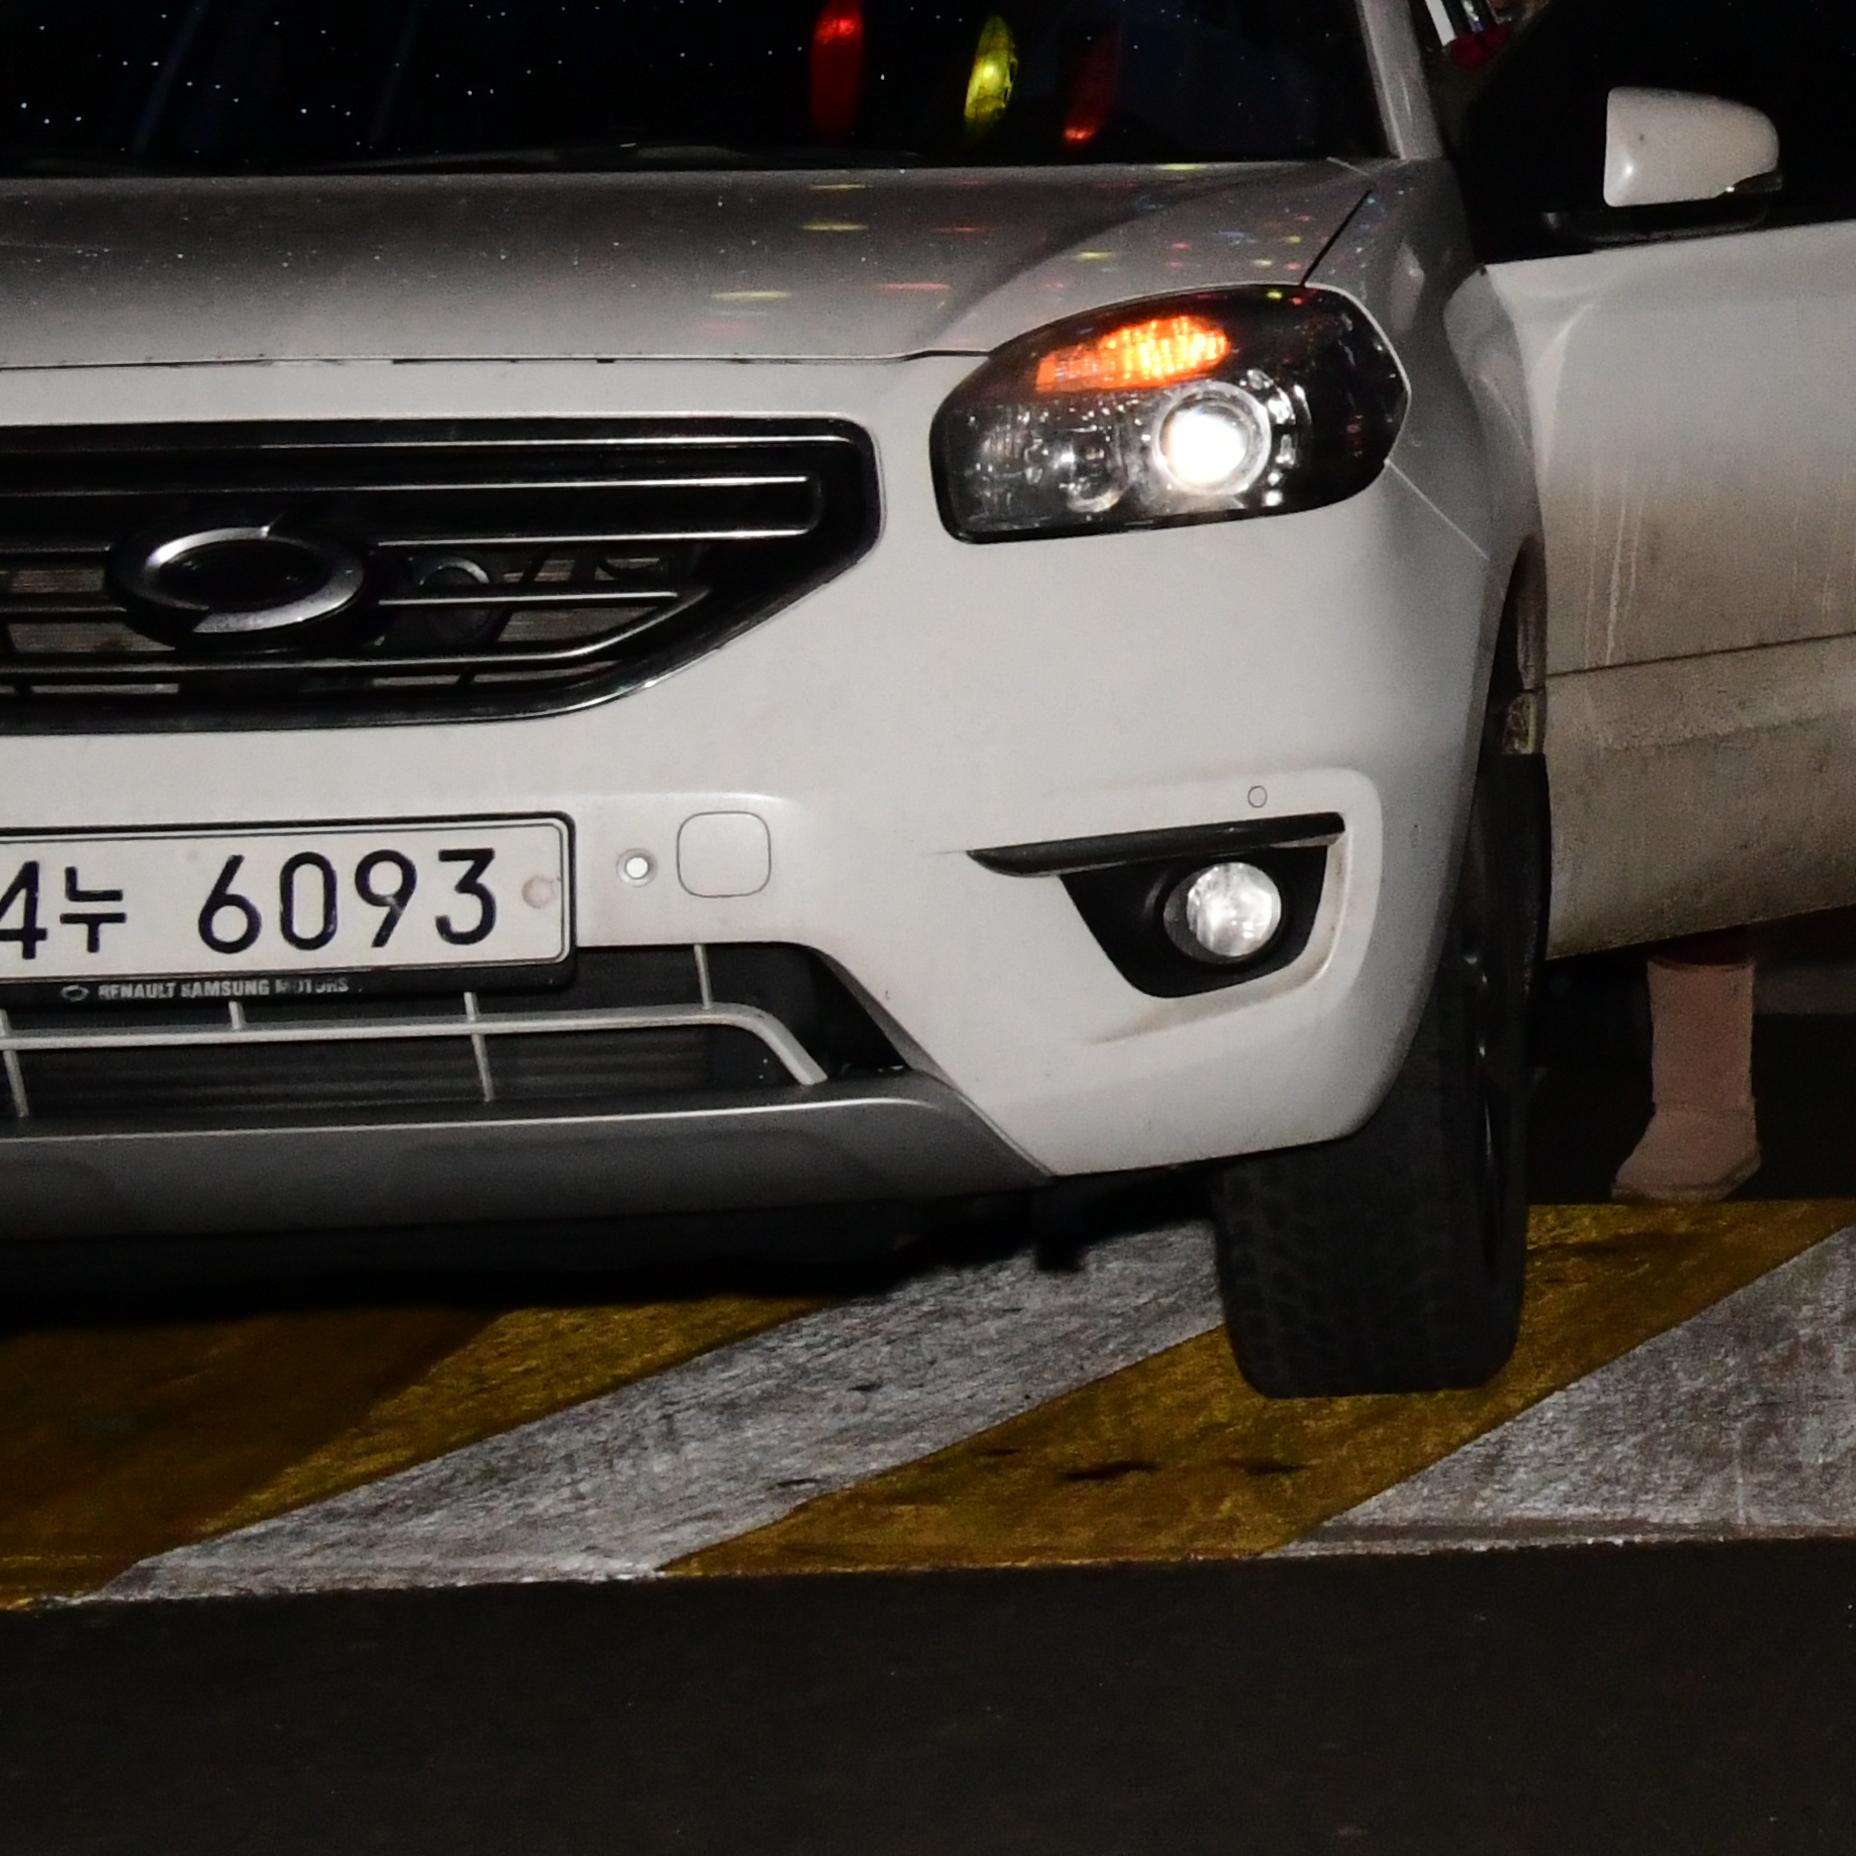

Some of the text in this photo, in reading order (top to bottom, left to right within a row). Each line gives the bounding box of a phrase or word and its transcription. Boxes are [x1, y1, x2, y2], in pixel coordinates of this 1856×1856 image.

[199, 848, 496, 954] 6093
[98, 982, 176, 1001] RENAULT
[180, 979, 270, 998] SAMSUNG
